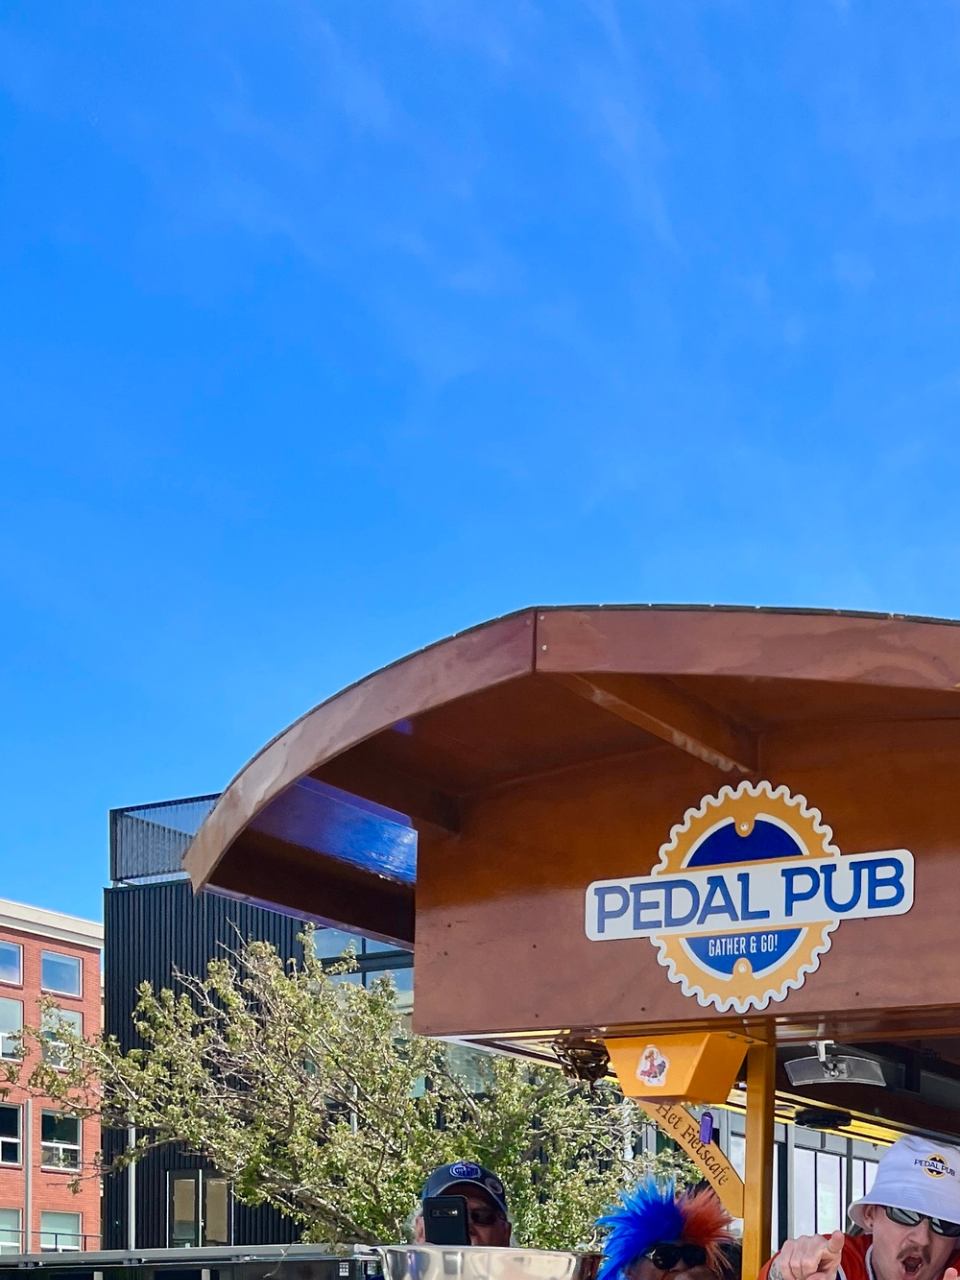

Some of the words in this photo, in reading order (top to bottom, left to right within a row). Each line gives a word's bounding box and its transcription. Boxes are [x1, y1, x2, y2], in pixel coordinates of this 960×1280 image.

[593, 872, 770, 934] PEDAL
[780, 857, 906, 917] PUB
[708, 937, 747, 957] GATHER
[750, 936, 757, 952] &
[761, 934, 778, 952] GO!
[914, 1159, 940, 1169] PEDAL
[941, 1165, 956, 1177] PUB
